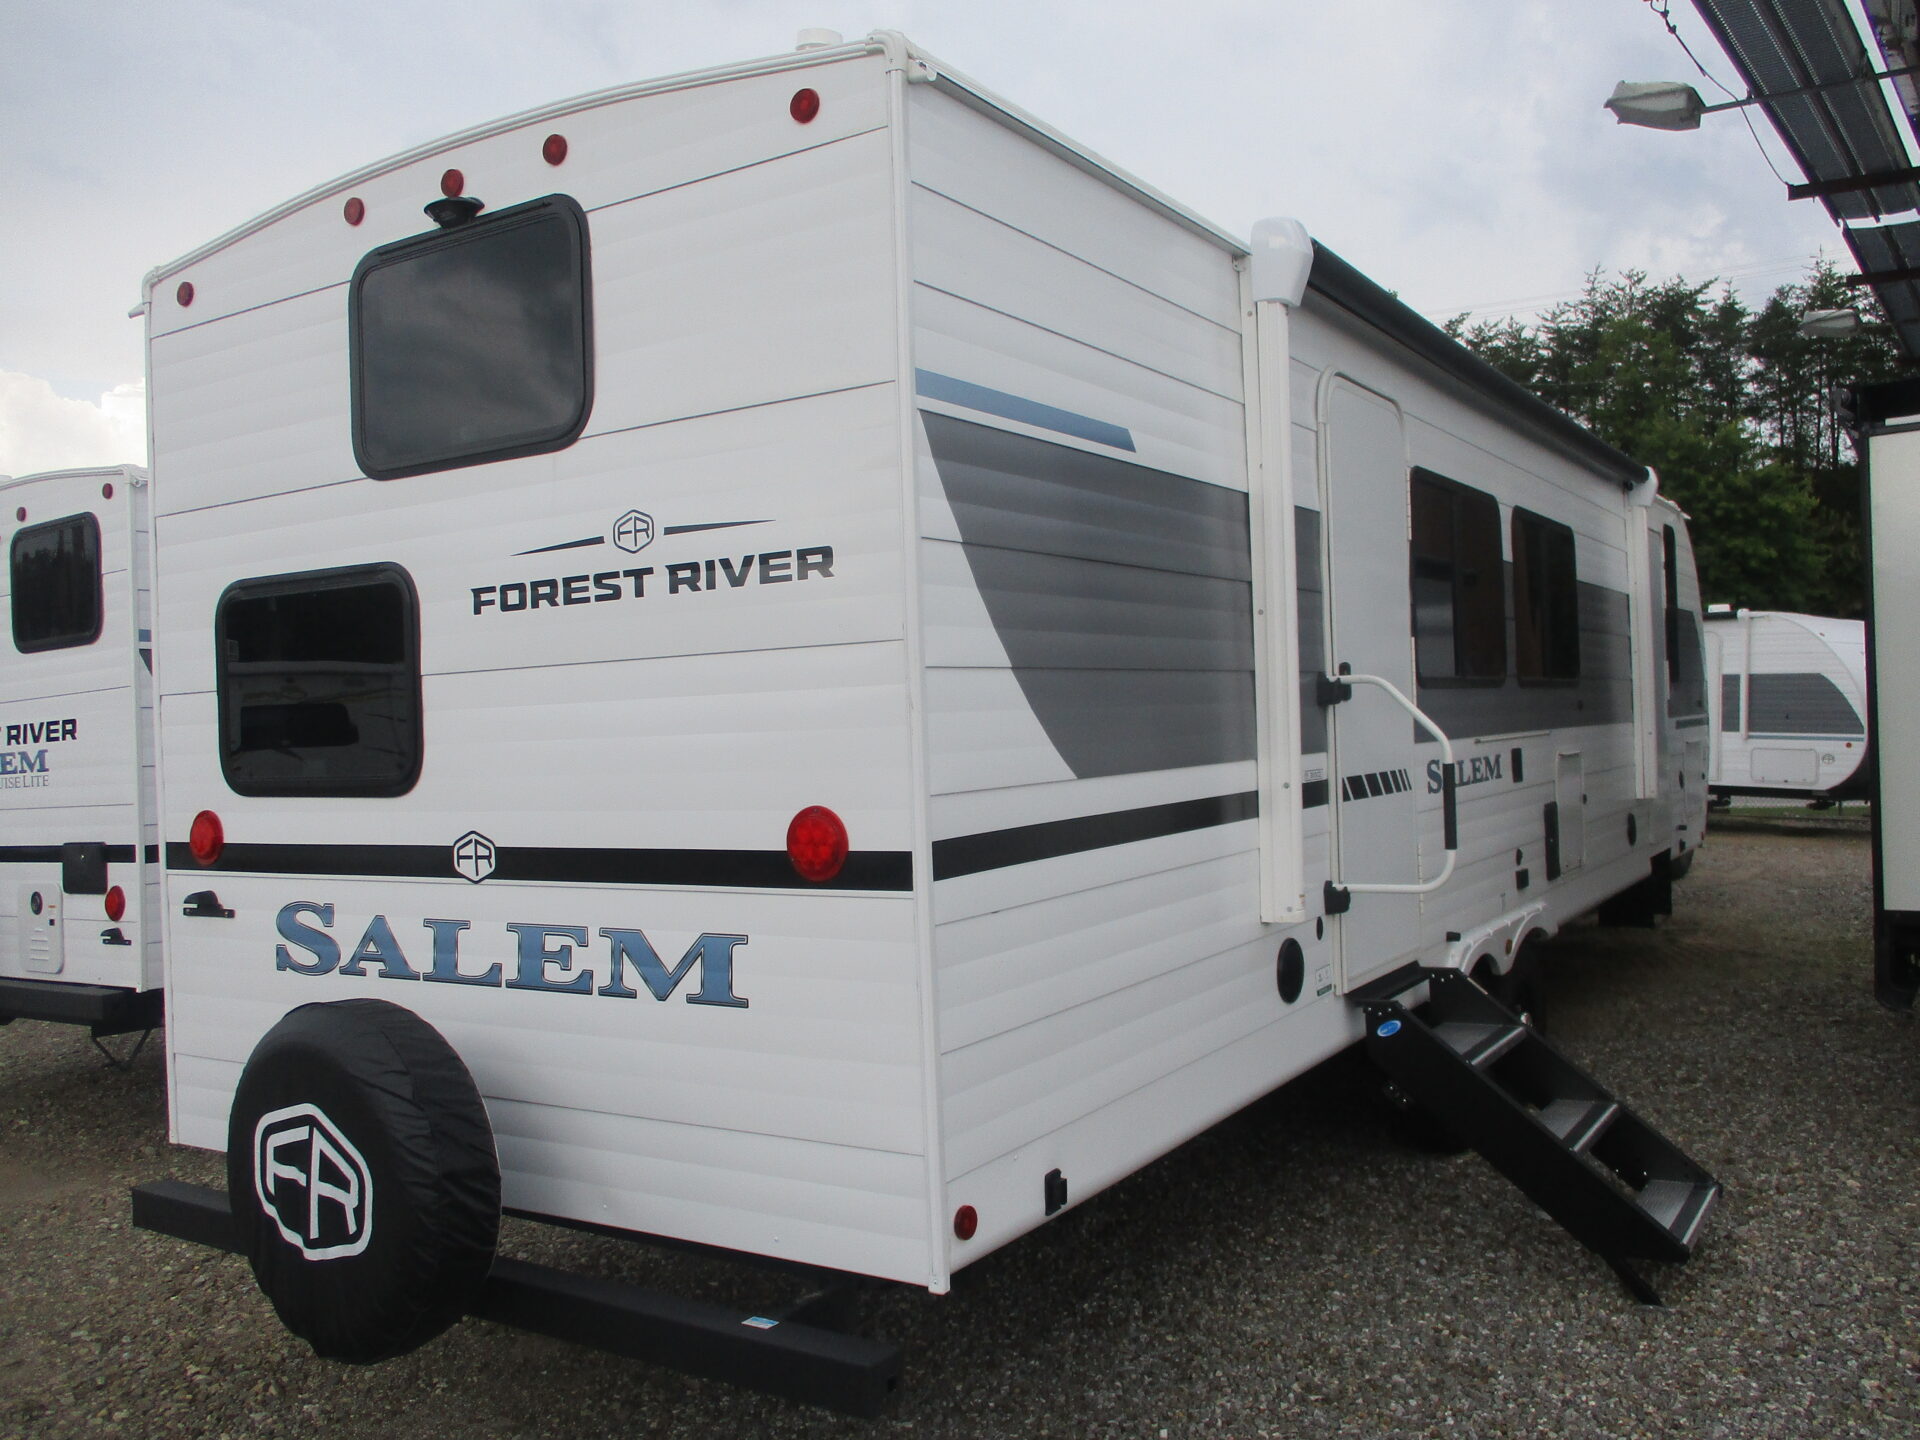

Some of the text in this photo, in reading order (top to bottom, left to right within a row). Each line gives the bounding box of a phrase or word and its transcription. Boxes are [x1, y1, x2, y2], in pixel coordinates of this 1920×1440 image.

[470, 546, 835, 615] FOREST RIVER
[6, 718, 77, 746] RIVER
[1426, 754, 1502, 794] SLEM
[275, 901, 748, 1008] SALEM
